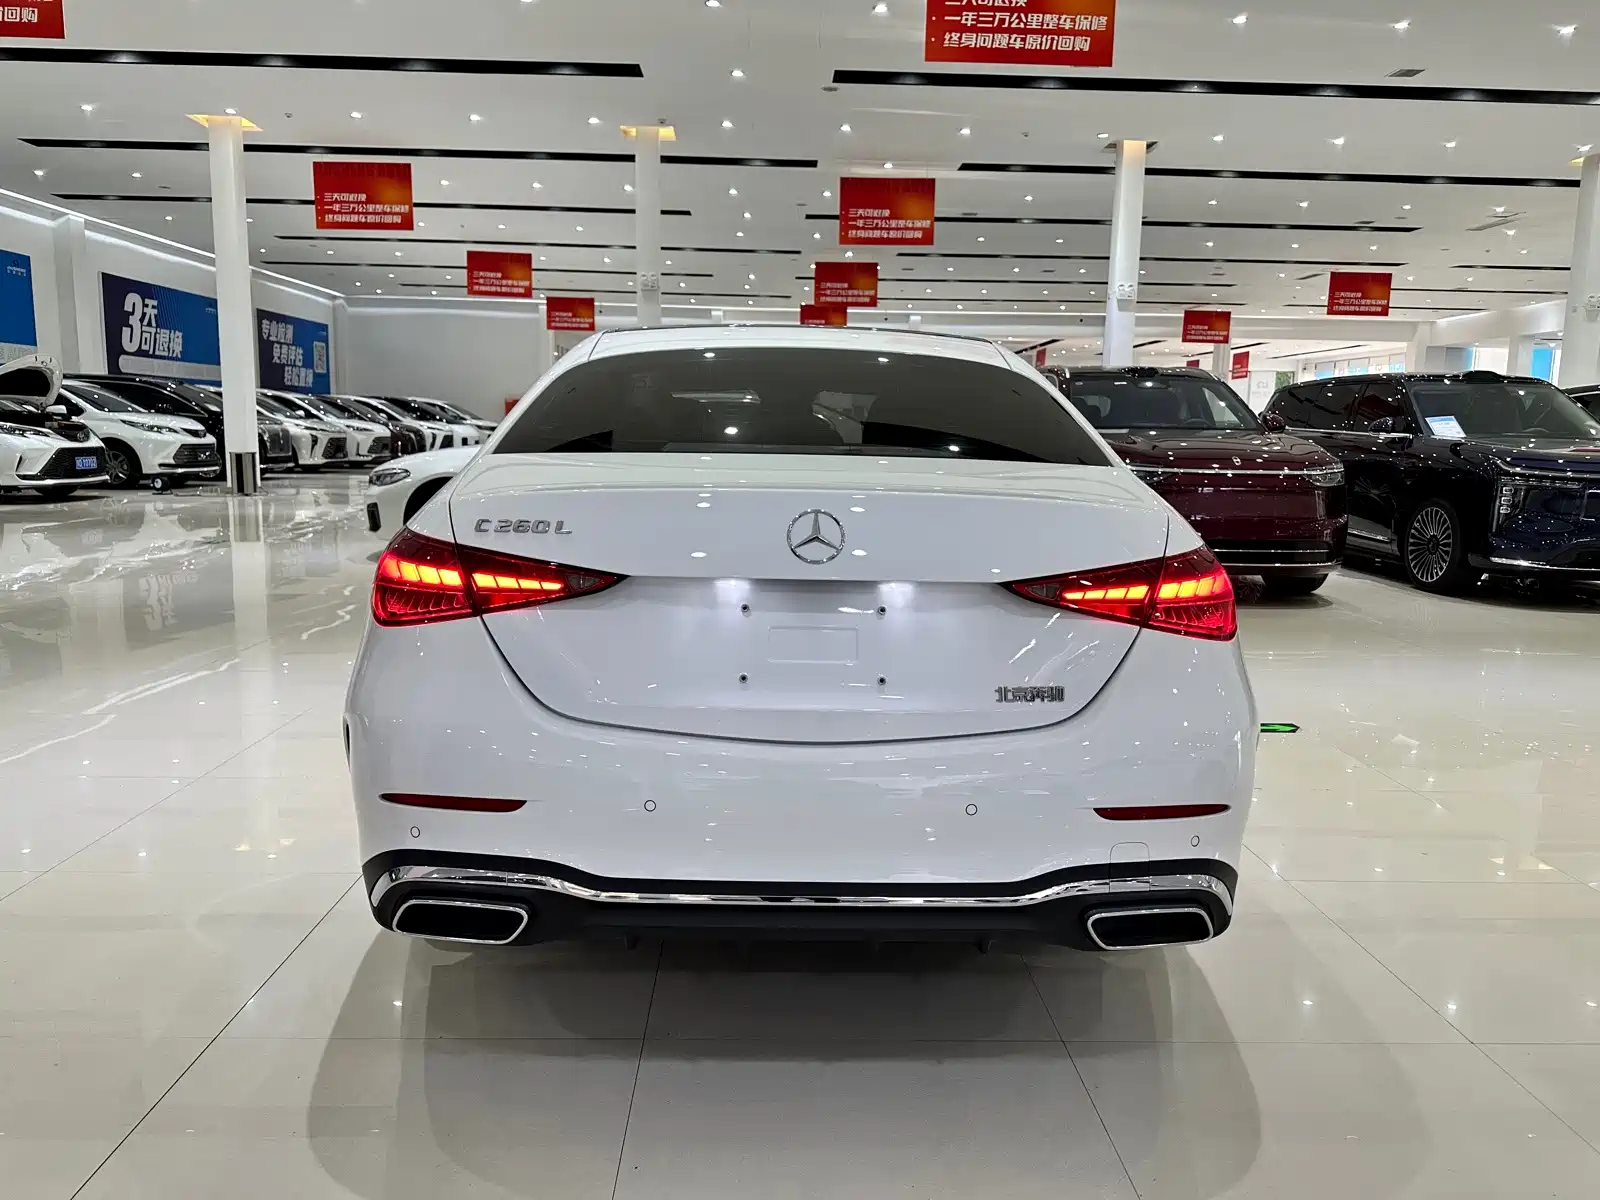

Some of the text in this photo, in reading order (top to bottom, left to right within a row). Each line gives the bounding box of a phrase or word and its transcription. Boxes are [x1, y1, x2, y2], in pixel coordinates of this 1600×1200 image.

[0, 6, 38, 22] 回购
[944, 11, 1108, 31] 一年三万公里整车保修
[943, 32, 1091, 52] 终身问题车原价回购
